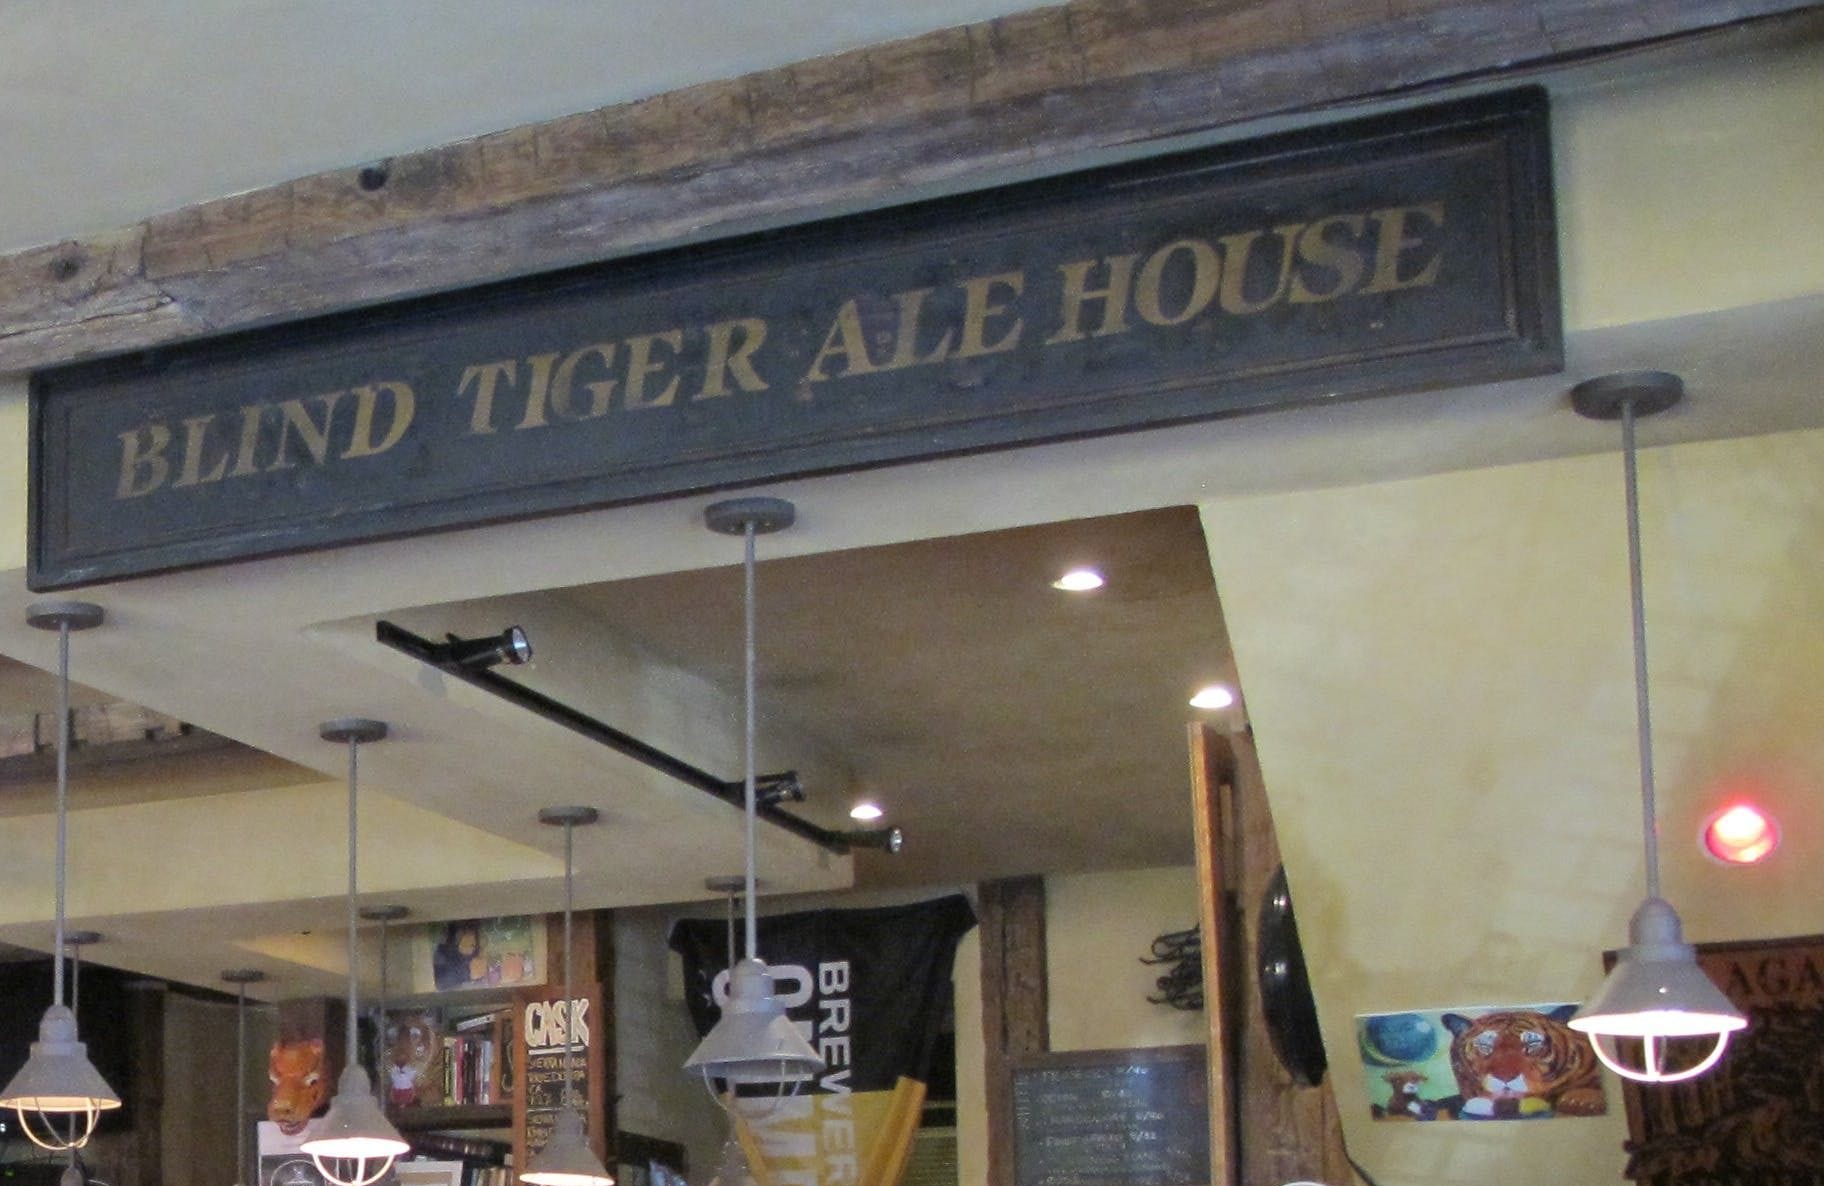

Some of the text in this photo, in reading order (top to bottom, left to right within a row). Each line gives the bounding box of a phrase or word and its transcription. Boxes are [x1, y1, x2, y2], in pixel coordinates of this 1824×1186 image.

[117, 201, 1444, 500] BLIND TIGER ALE HOUSE
[525, 998, 590, 1048] CASK
